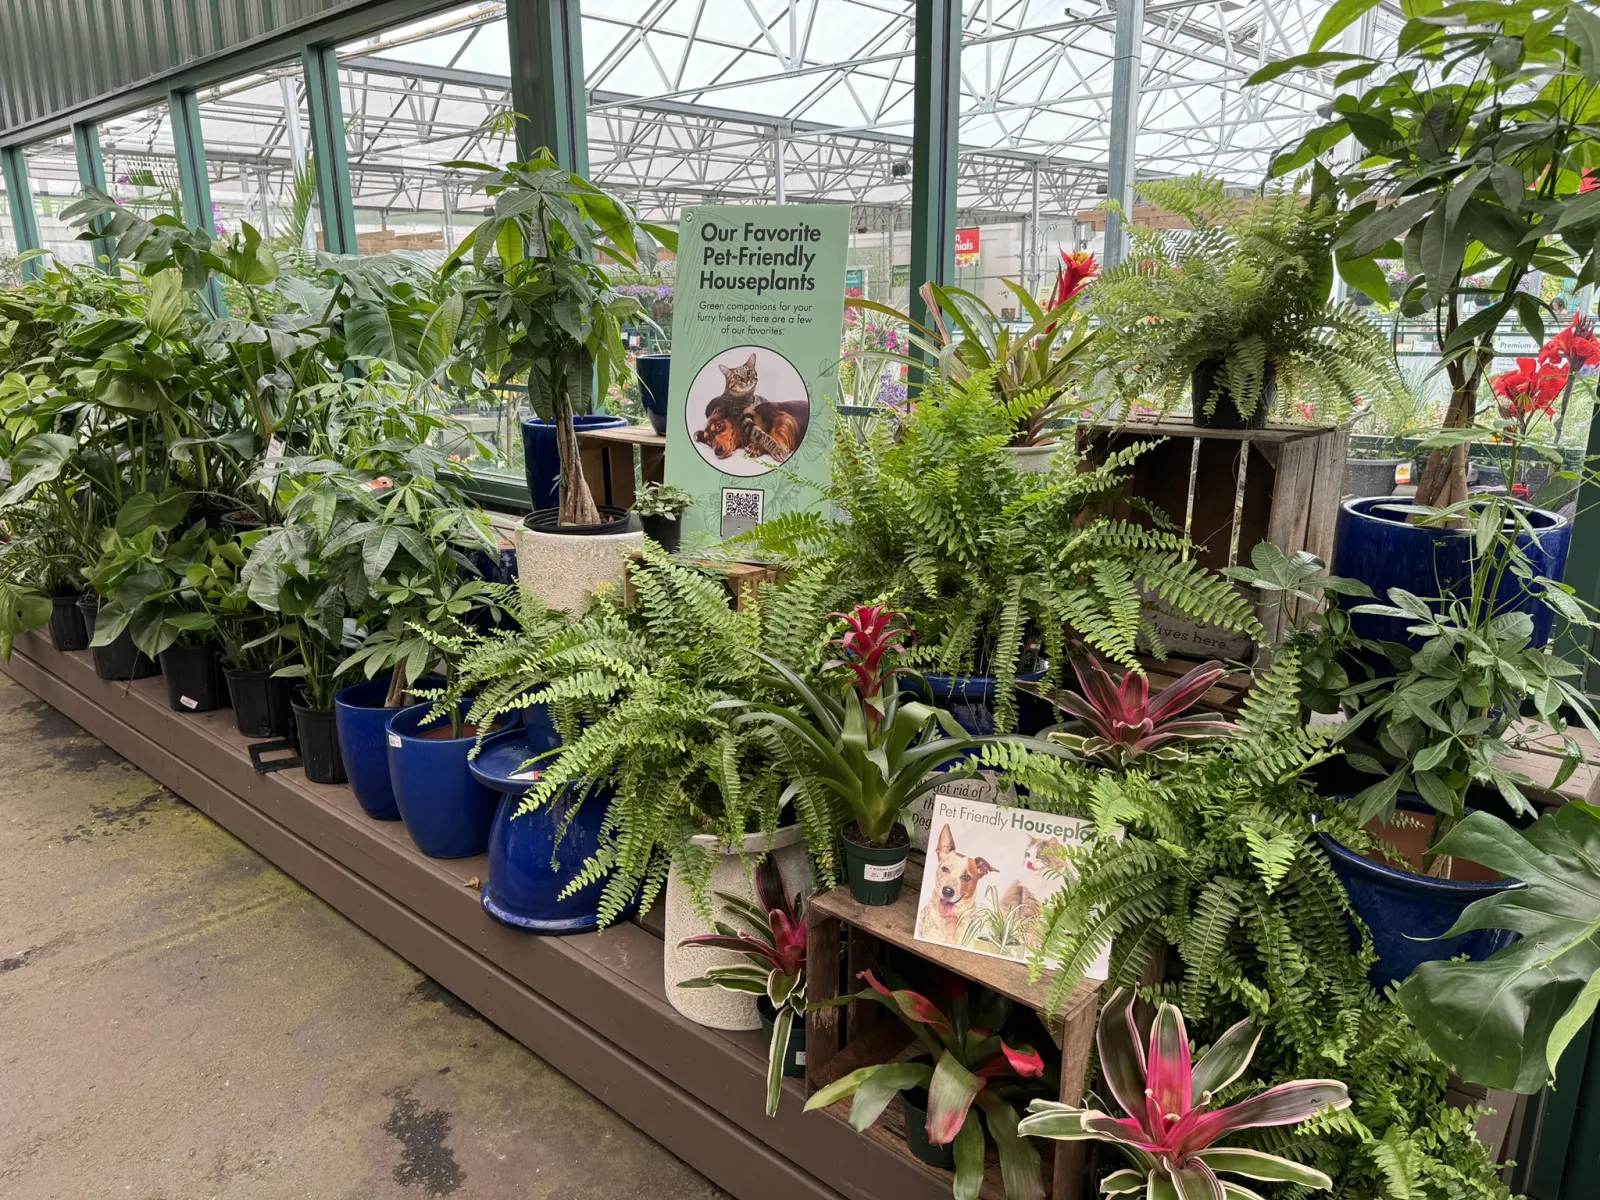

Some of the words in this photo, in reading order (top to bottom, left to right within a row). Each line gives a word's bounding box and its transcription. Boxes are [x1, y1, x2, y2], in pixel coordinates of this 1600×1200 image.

[701, 222, 737, 242] Our
[744, 222, 821, 242] Favorite
[703, 245, 816, 272] Pet-Friendly
[700, 269, 815, 295] Houseplants
[699, 301, 724, 310] Green
[727, 303, 776, 313] companions
[779, 302, 791, 311] for
[793, 305, 812, 313] your
[697, 312, 716, 324] furry
[718, 313, 748, 324] friends,
[751, 314, 769, 323] here
[797, 315, 812, 323] few
[721, 325, 730, 335] of
[747, 325, 785, 336] favorites.
[1499, 341, 1532, 349] Premium
[1192, 631, 1230, 651] here.
[933, 783, 952, 796] got
[952, 783, 969, 797] rid
[971, 787, 985, 801] of
[939, 802, 957, 818] Pet
[959, 806, 1009, 831] Friendly
